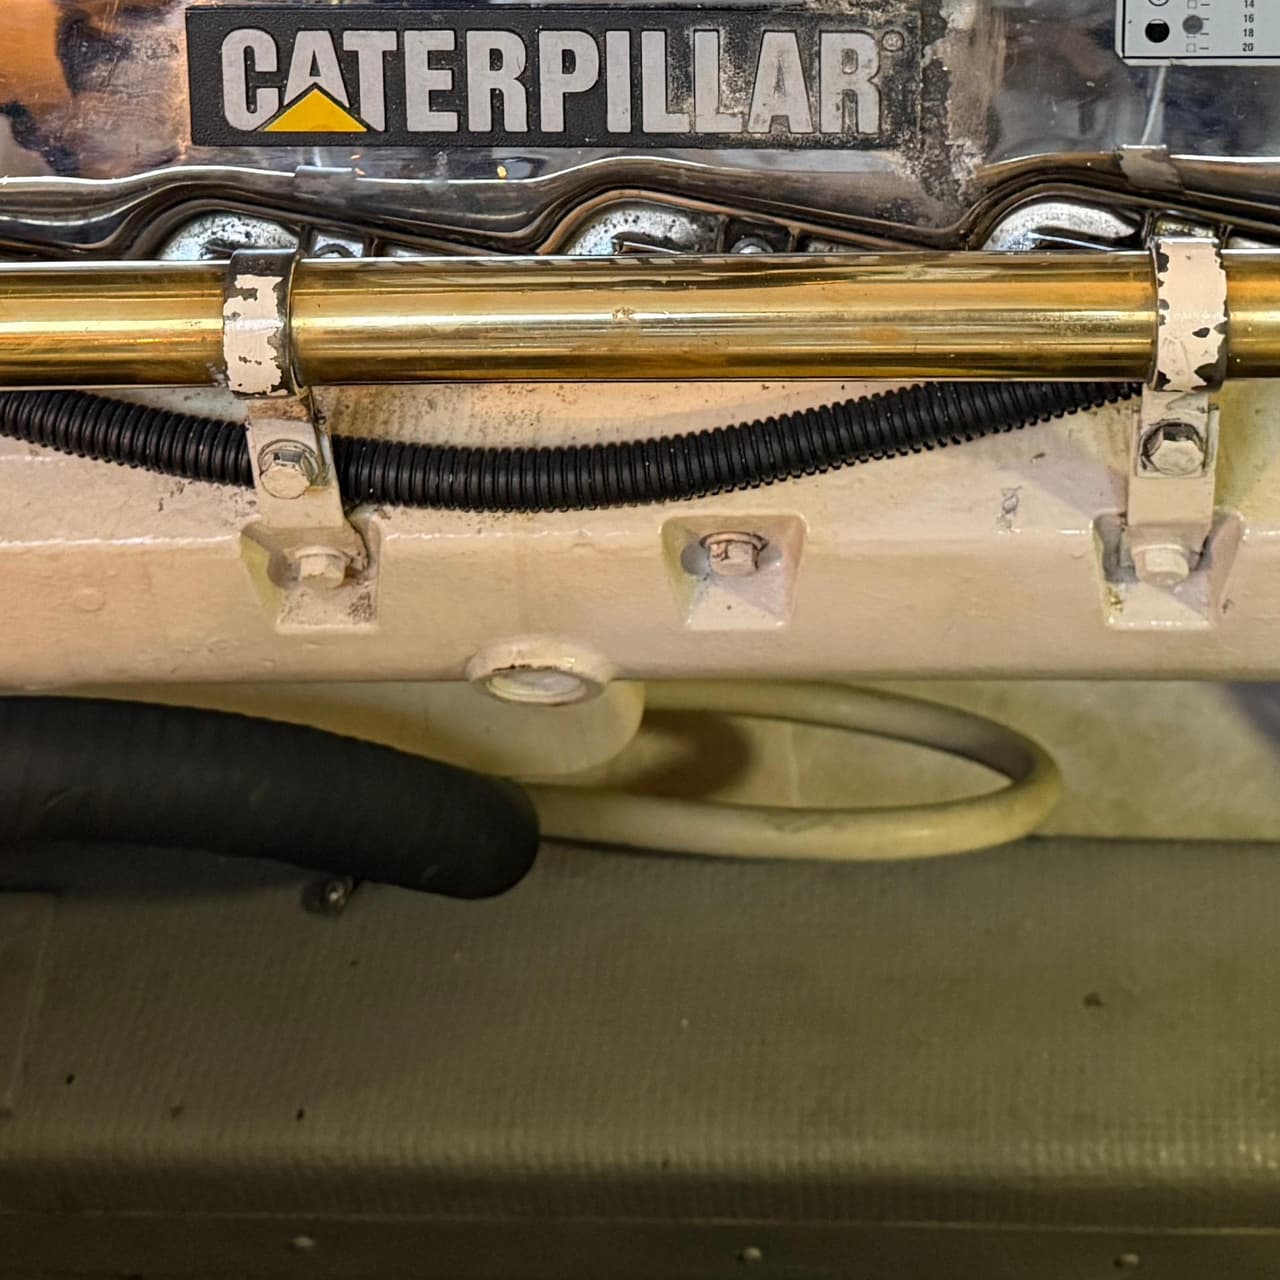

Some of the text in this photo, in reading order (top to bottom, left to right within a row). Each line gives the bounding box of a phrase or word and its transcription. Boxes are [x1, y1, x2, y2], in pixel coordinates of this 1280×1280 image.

[1244, 0, 1255, 9] 14
[1243, 13, 1254, 23] 16
[1243, 28, 1254, 38] 18
[1242, 42, 1253, 52] 20
[220, 27, 880, 134] CATERPILLAR
